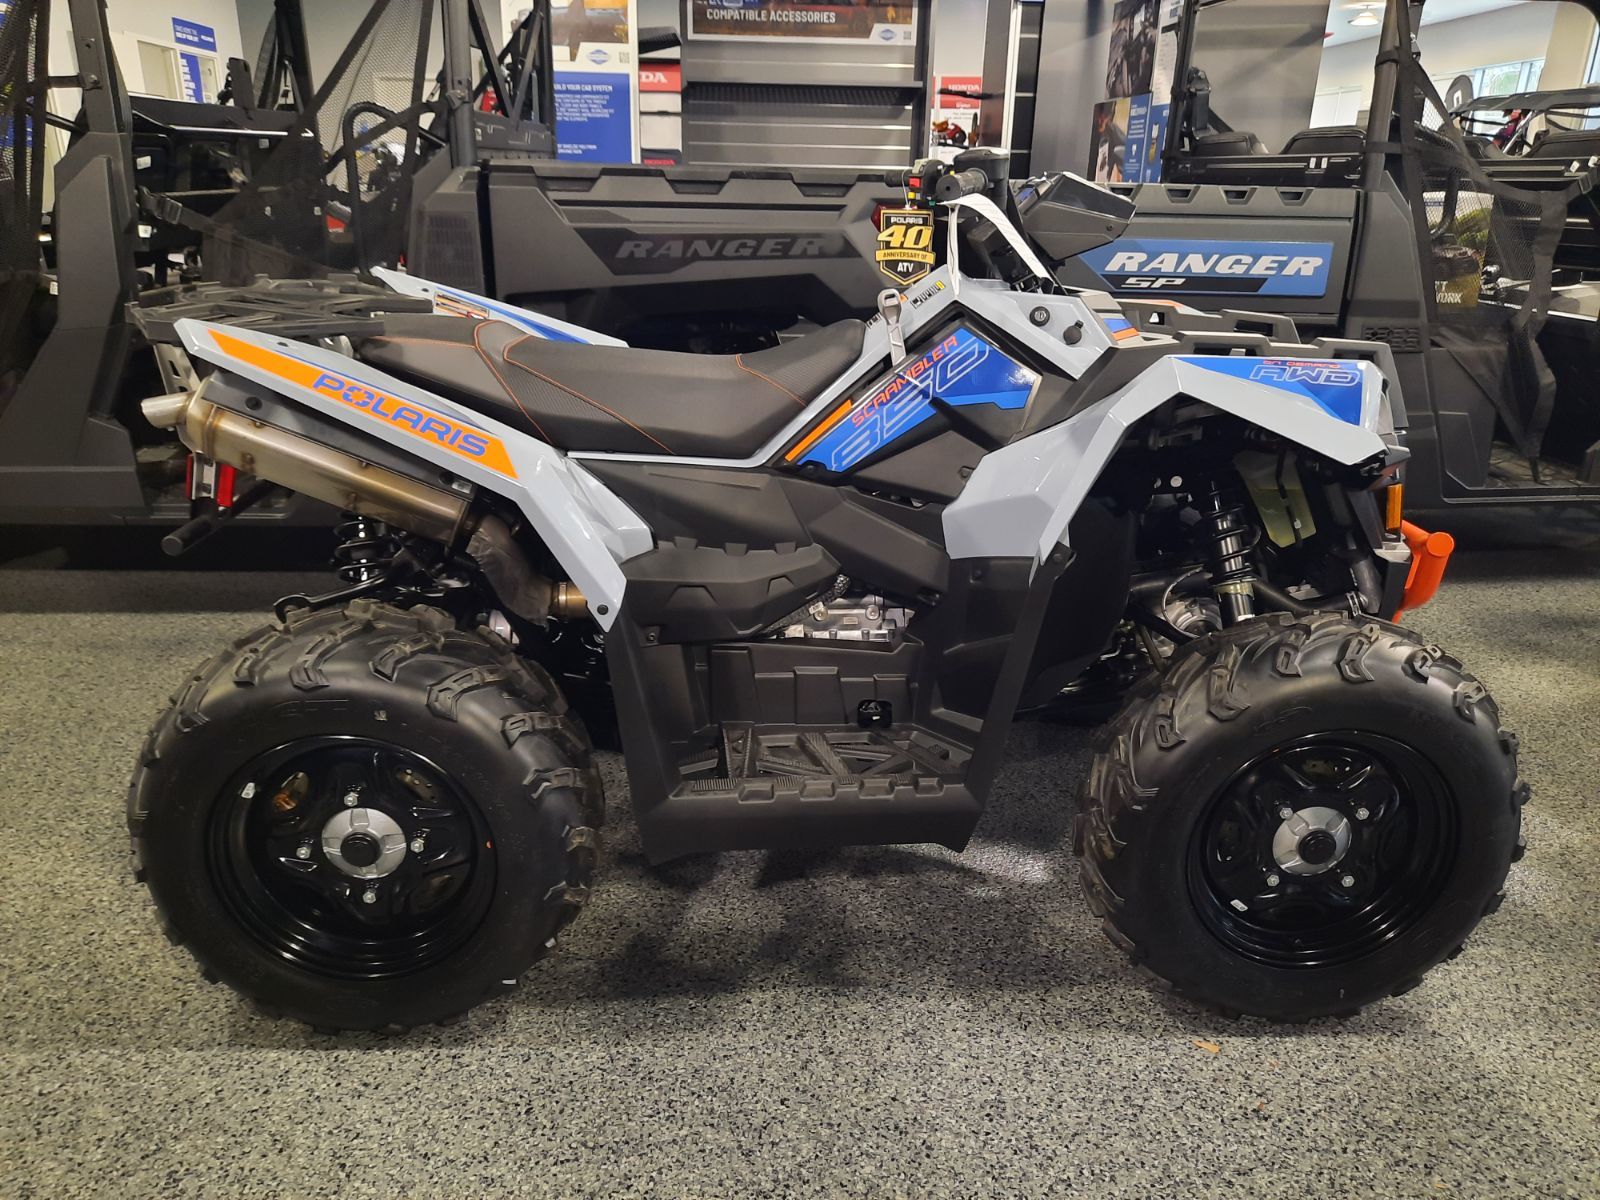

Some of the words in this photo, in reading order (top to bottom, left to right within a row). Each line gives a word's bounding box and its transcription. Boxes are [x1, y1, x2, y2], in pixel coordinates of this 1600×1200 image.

[706, 8, 767, 21] COMPATIBLE
[769, 10, 836, 24] ACCESSORIES
[890, 216, 923, 225] POLARIS
[615, 239, 830, 259] RANGER
[882, 251, 920, 259] ANNIVERSARY
[897, 261, 914, 273] ATV
[1104, 251, 1324, 276] RANGER
[1121, 277, 1187, 289] SP
[851, 335, 959, 429] SCRAMBLER
[1249, 364, 1361, 387] AWD
[832, 336, 990, 472] 850
[312, 373, 490, 457] POLARIS
